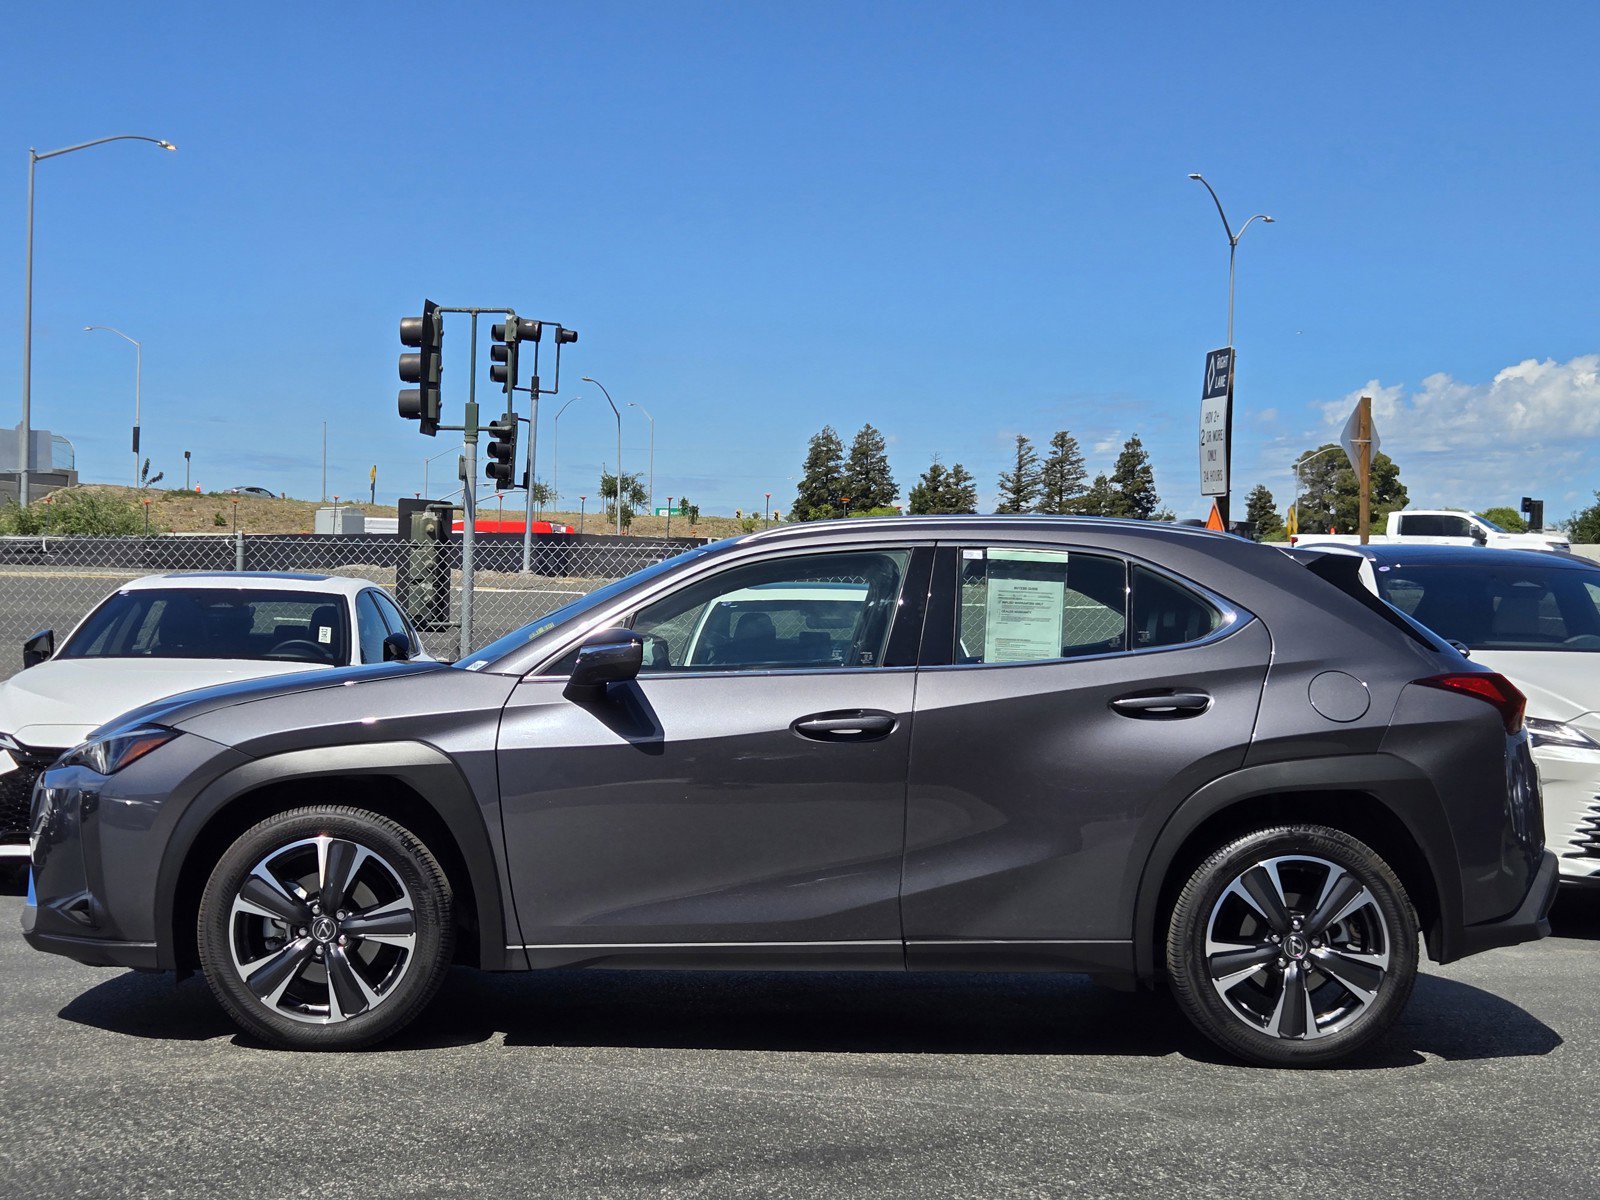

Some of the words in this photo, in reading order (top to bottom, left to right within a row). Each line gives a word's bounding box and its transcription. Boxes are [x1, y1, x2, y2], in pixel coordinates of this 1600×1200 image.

[1215, 375, 1226, 388] LANE
[1213, 411, 1220, 423] 2+
[1201, 429, 1206, 446] 2
[1206, 430, 1212, 442] OR
[1212, 429, 1223, 441] MORE
[1207, 449, 1216, 461] ONLY
[1204, 471, 1209, 482] 24
[1210, 468, 1223, 482] HOURS
